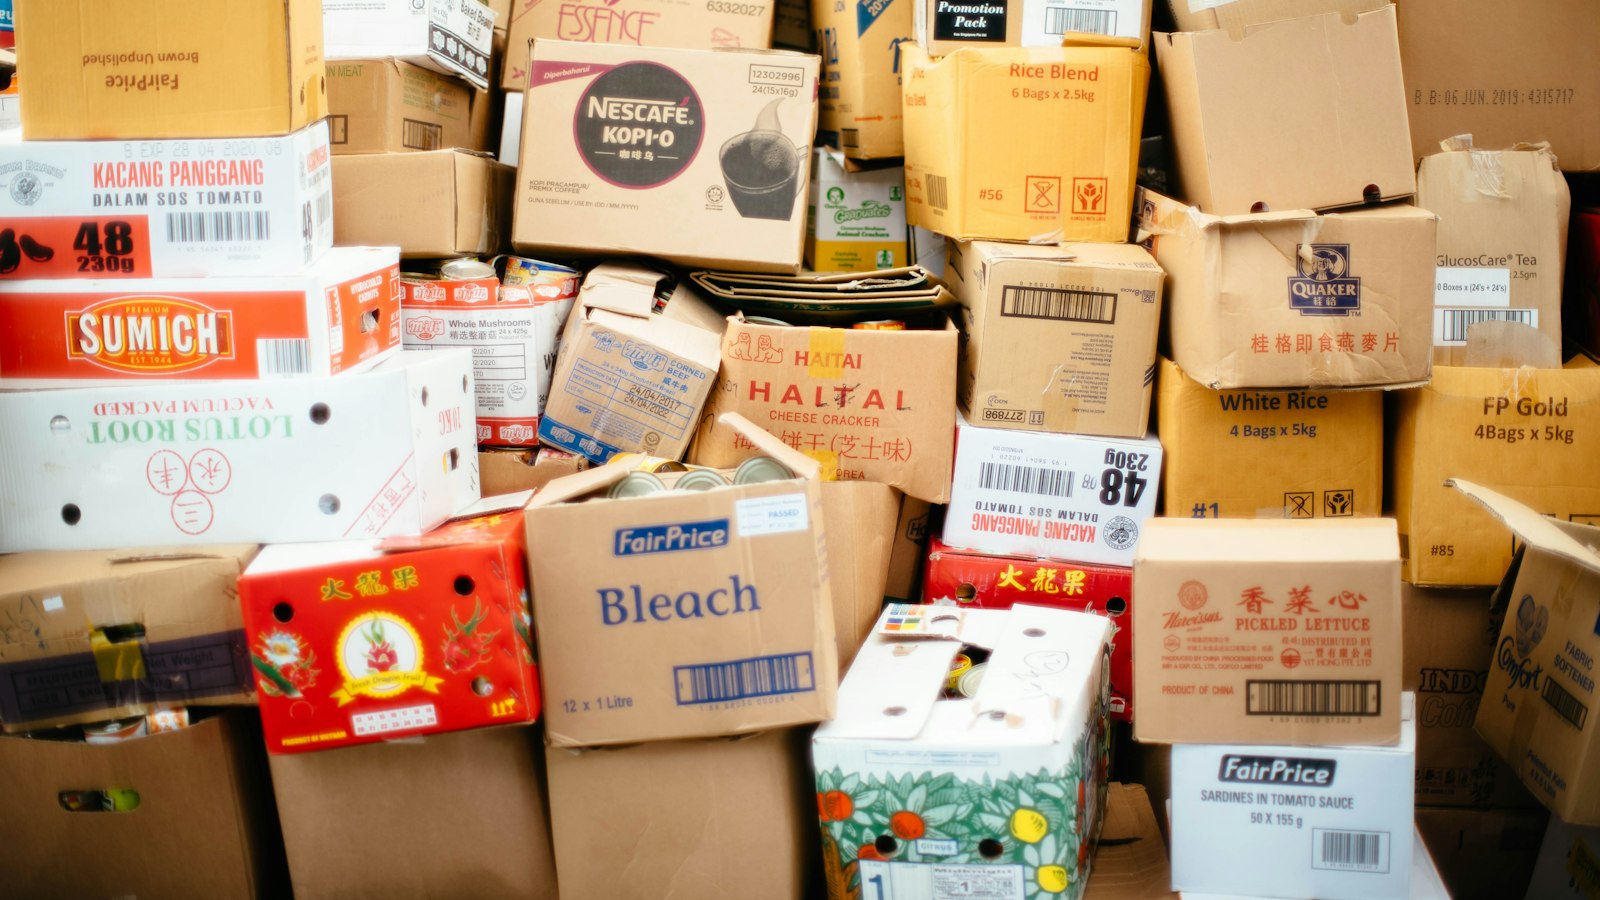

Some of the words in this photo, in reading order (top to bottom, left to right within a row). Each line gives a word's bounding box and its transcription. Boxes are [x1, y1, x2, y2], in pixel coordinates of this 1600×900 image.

[706, 1, 765, 17] 6332027
[937, 3, 1004, 15] Promotion
[954, 16, 987, 29] Pack
[83, 51, 154, 66] Unpolished
[158, 51, 199, 64] Brown
[337, 65, 363, 78] MEAT
[543, 65, 592, 80] Diperbaharui
[752, 69, 801, 82] 12302996
[1009, 62, 1045, 80] Rice
[1050, 64, 1099, 82] Blend
[105, 72, 179, 92] FairPrice
[752, 85, 798, 98] 24(15x16g)
[1012, 87, 1019, 98] 6
[1023, 88, 1049, 102] Bags
[1053, 91, 1060, 100] x
[1063, 89, 1095, 102] 2.5kg
[602, 126, 675, 148] KOPI-O
[173, 143, 190, 157] 28
[199, 143, 215, 157] 04
[224, 142, 256, 156] 2020
[93, 161, 164, 188] KACANG
[169, 159, 265, 187] PANGGANG
[93, 192, 149, 208] DALAM
[157, 191, 188, 206] SOS
[196, 190, 263, 206] TOMATO
[545, 198, 570, 206] SEBELUM
[979, 189, 1003, 202] #56
[72, 221, 135, 256] 48
[76, 255, 135, 274] 230g
[1516, 253, 1537, 266] Tea
[1513, 271, 1538, 281] 2.5gm
[1291, 281, 1357, 298] QUAKER
[1443, 284, 1462, 293] Boxes
[126, 306, 169, 314] PREMIUM
[448, 320, 477, 328] Whole
[478, 319, 532, 328] Mushrooms
[513, 328, 528, 336] 425g
[78, 311, 219, 355] SUMICH
[130, 356, 146, 364] EST
[149, 356, 172, 364] 1944
[794, 350, 862, 370] HAITAI
[666, 367, 690, 380] BEEF
[670, 360, 706, 380] CORNED
[183, 397, 274, 414] VACUUM
[624, 394, 669, 418] 24/04/2022
[630, 384, 682, 411] 24/04/2017
[1220, 392, 1281, 412] White
[1286, 392, 1329, 410] Rice
[94, 400, 177, 416] PACKED
[985, 410, 1024, 421] 277898
[1483, 396, 1509, 416] FP
[1516, 396, 1568, 418] Gold
[769, 410, 817, 424] CHEESE
[822, 414, 880, 428] CRACKER
[86, 420, 176, 444] ROOT
[186, 414, 293, 442] LOTUS
[1230, 425, 1239, 437] 4
[1243, 424, 1276, 440] Bags
[1281, 427, 1288, 436] x
[1291, 423, 1317, 438] 5kg
[1474, 425, 1526, 443] 4Bags
[1530, 429, 1539, 440] x
[1544, 425, 1574, 445] 5kg
[733, 430, 913, 462] 海饼干(芝士味)
[1104, 448, 1150, 470] 230g
[194, 456, 224, 487] 永
[1098, 468, 1148, 507] 48
[768, 508, 800, 518] PASSED
[975, 502, 1024, 517] TOMATO
[1028, 506, 1052, 518] SOS
[1056, 510, 1098, 523] DALAM
[1192, 502, 1220, 518] #1
[972, 513, 1040, 537] PANGGANG
[1043, 520, 1096, 544] KACANG
[618, 526, 726, 554] FairPrice
[1431, 545, 1454, 557] #85
[320, 566, 419, 601] 火龍果
[998, 564, 1086, 596] 火龍果
[596, 574, 762, 626] Bleach
[1236, 584, 1369, 615] 香菜心
[1235, 618, 1298, 632] PICKLED
[1305, 618, 1371, 632] LETTUCE
[1302, 637, 1356, 646] DISTRIBUTED
[1360, 637, 1372, 646] BY
[171, 650, 214, 667] Weight
[1304, 658, 1318, 667] YIT
[1320, 658, 1341, 667] HONG
[1357, 658, 1372, 667] LTD
[1564, 640, 1594, 670] FABRIC
[1498, 636, 1544, 692] Comfort
[372, 675, 400, 685] Dragon
[402, 674, 422, 682] Fruit
[1554, 654, 1596, 694] SOFTENER
[1162, 686, 1196, 695] PRODUCT
[1199, 686, 1209, 695] OF
[1212, 686, 1234, 695] CHINA
[563, 700, 578, 712] 12
[583, 702, 590, 711] x
[597, 698, 602, 710] 1
[606, 696, 634, 710] Litre
[282, 734, 310, 746] PRODUCT
[319, 730, 347, 743] VIETNAM
[1224, 758, 1330, 784] FairPrice
[1200, 790, 1254, 804] SARDINES
[1256, 793, 1268, 804] IN
[1272, 794, 1316, 808] TOMATO
[1318, 796, 1354, 810] SAUCE
[1250, 812, 1263, 824] 50
[1265, 812, 1272, 824] X
[1276, 813, 1294, 826] 155
[1296, 817, 1302, 829] g
[868, 874, 885, 900] 1
